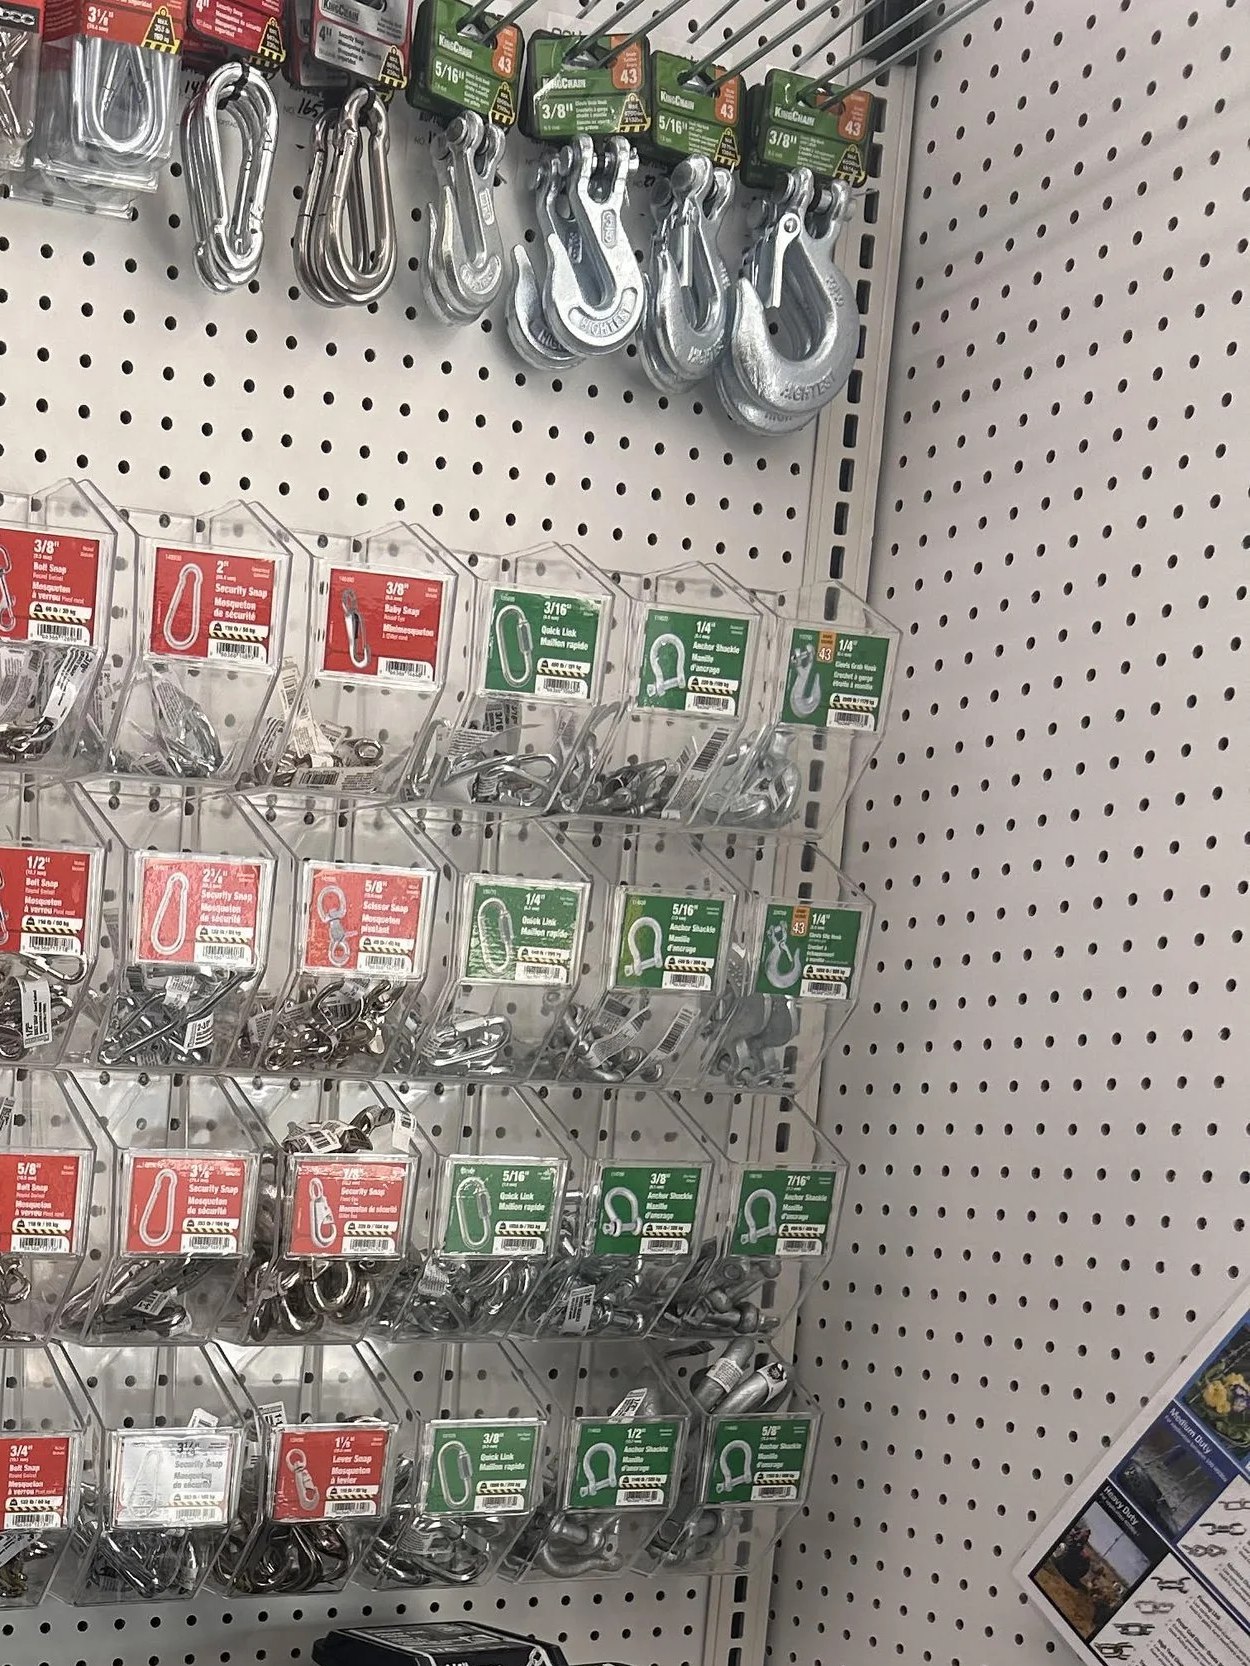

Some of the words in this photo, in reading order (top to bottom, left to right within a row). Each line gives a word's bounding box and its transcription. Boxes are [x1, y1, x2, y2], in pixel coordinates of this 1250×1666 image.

[435, 61, 464, 83] 5/16"
[498, 56, 511, 73] 43
[620, 69, 638, 84] 43
[542, 103, 573, 119] 3/8"
[720, 105, 734, 119] 43
[659, 115, 688, 134] 5/16"
[845, 122, 860, 136] 43
[769, 130, 797, 147] 3/8"
[215, 583, 246, 597] Security
[248, 586, 268, 600] Snap
[544, 601, 572, 616] 3/16"
[27, 855, 52, 870] 1/2"
